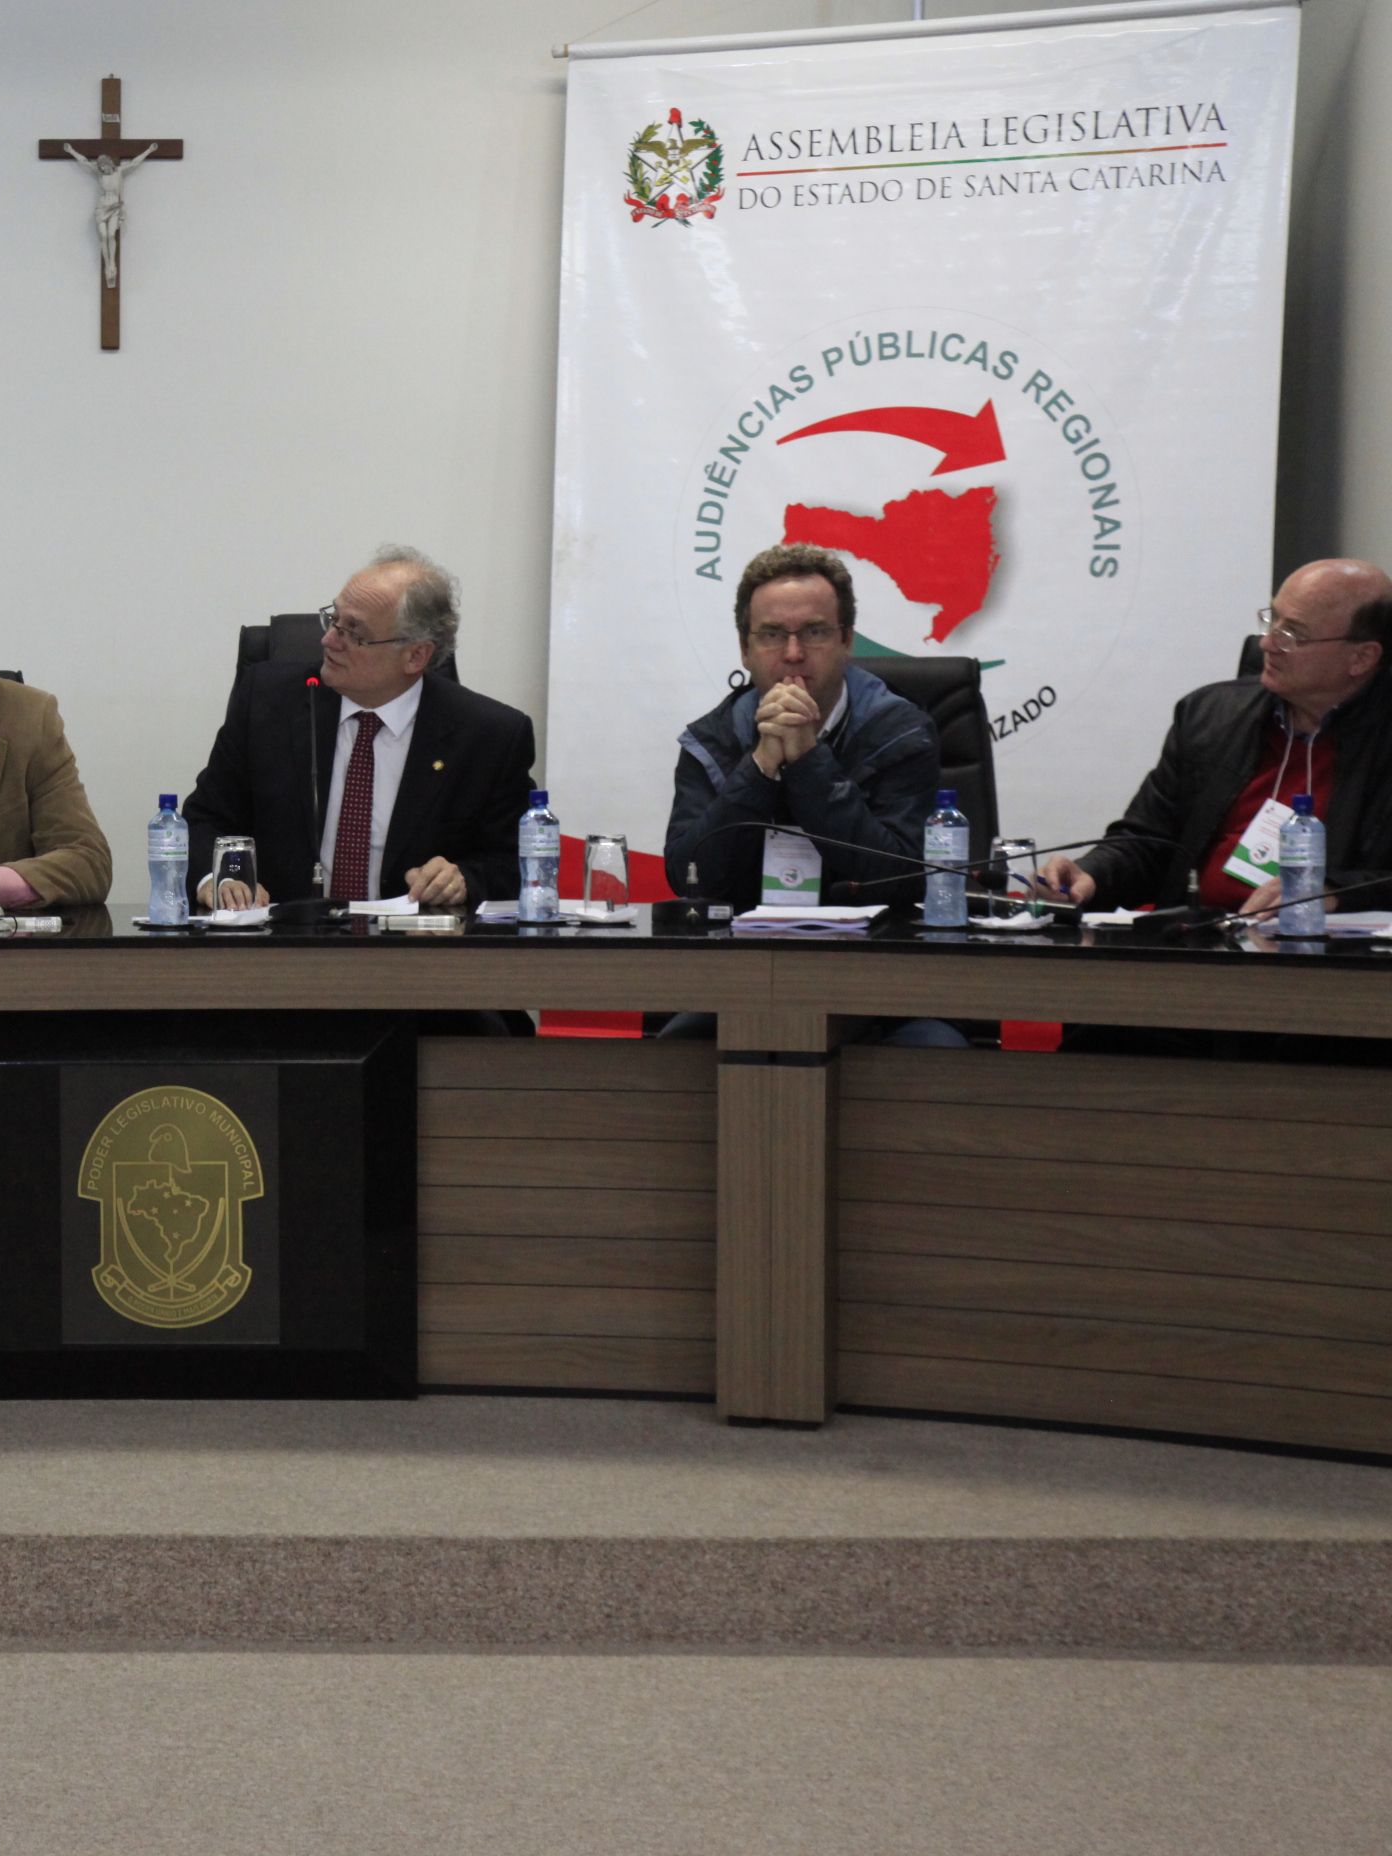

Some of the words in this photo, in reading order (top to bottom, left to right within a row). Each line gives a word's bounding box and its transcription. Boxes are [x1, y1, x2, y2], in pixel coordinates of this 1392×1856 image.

[741, 120, 966, 162] ASSEMBLEIA
[982, 101, 1228, 149] LEGISLATIVA
[738, 186, 782, 211] DO
[792, 179, 904, 208] ESTADO
[915, 175, 952, 201] DE
[964, 170, 1059, 199] SANTA
[1068, 160, 1228, 192] CATARINA
[694, 364, 814, 582] AUDIÊNCIAS
[821, 330, 1019, 381] PÚBLICAS
[1021, 369, 1123, 579] REGIONAIS
[87, 1134, 114, 1191] PODER
[113, 1095, 207, 1136] LEGISLATIVO
[208, 1109, 256, 1192] MUNICIPAL
